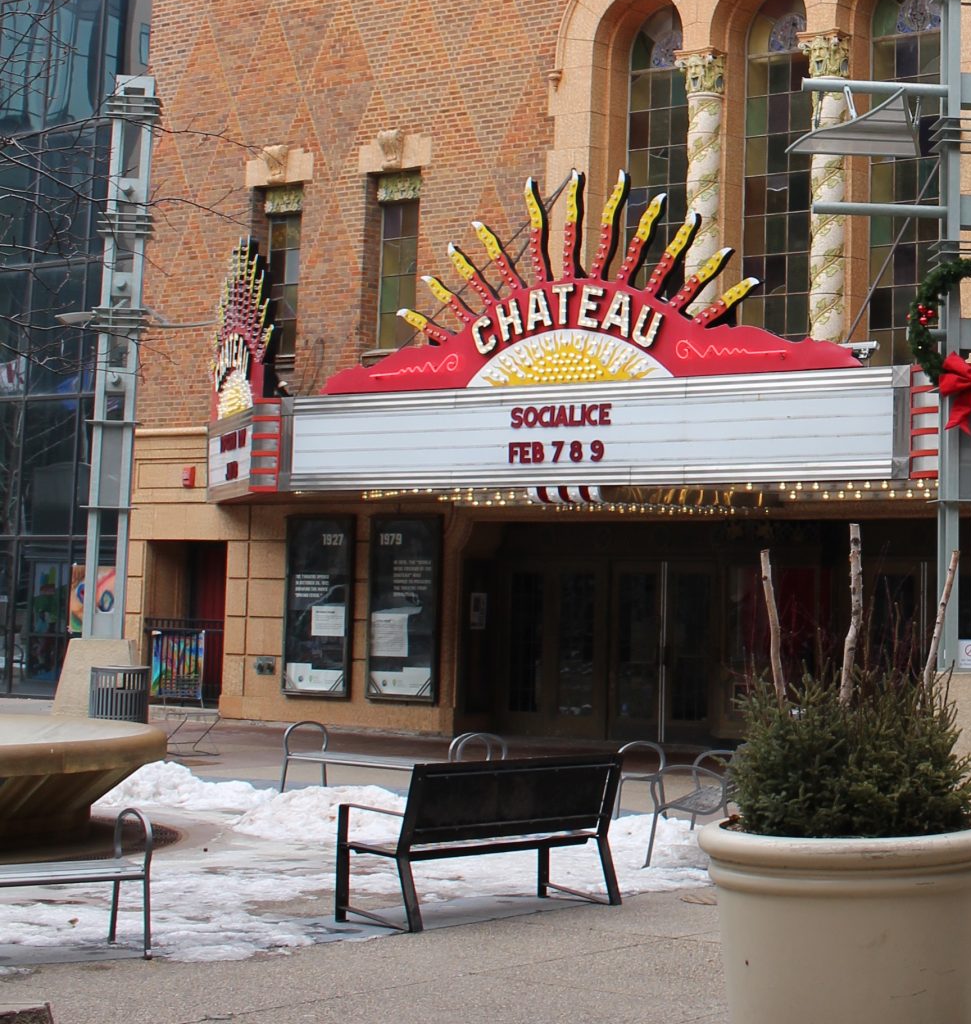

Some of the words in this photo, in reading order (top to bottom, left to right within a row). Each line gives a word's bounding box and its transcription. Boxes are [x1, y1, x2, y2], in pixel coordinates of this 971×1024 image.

[471, 282, 665, 355] CHATEAU
[510, 403, 612, 429] SOCIALICE
[508, 441, 545, 464] FEB
[551, 441, 565, 463] 7
[569, 440, 583, 463] 8
[590, 439, 605, 462] 9
[322, 533, 344, 546] 1927
[380, 533, 402, 545] 1979
